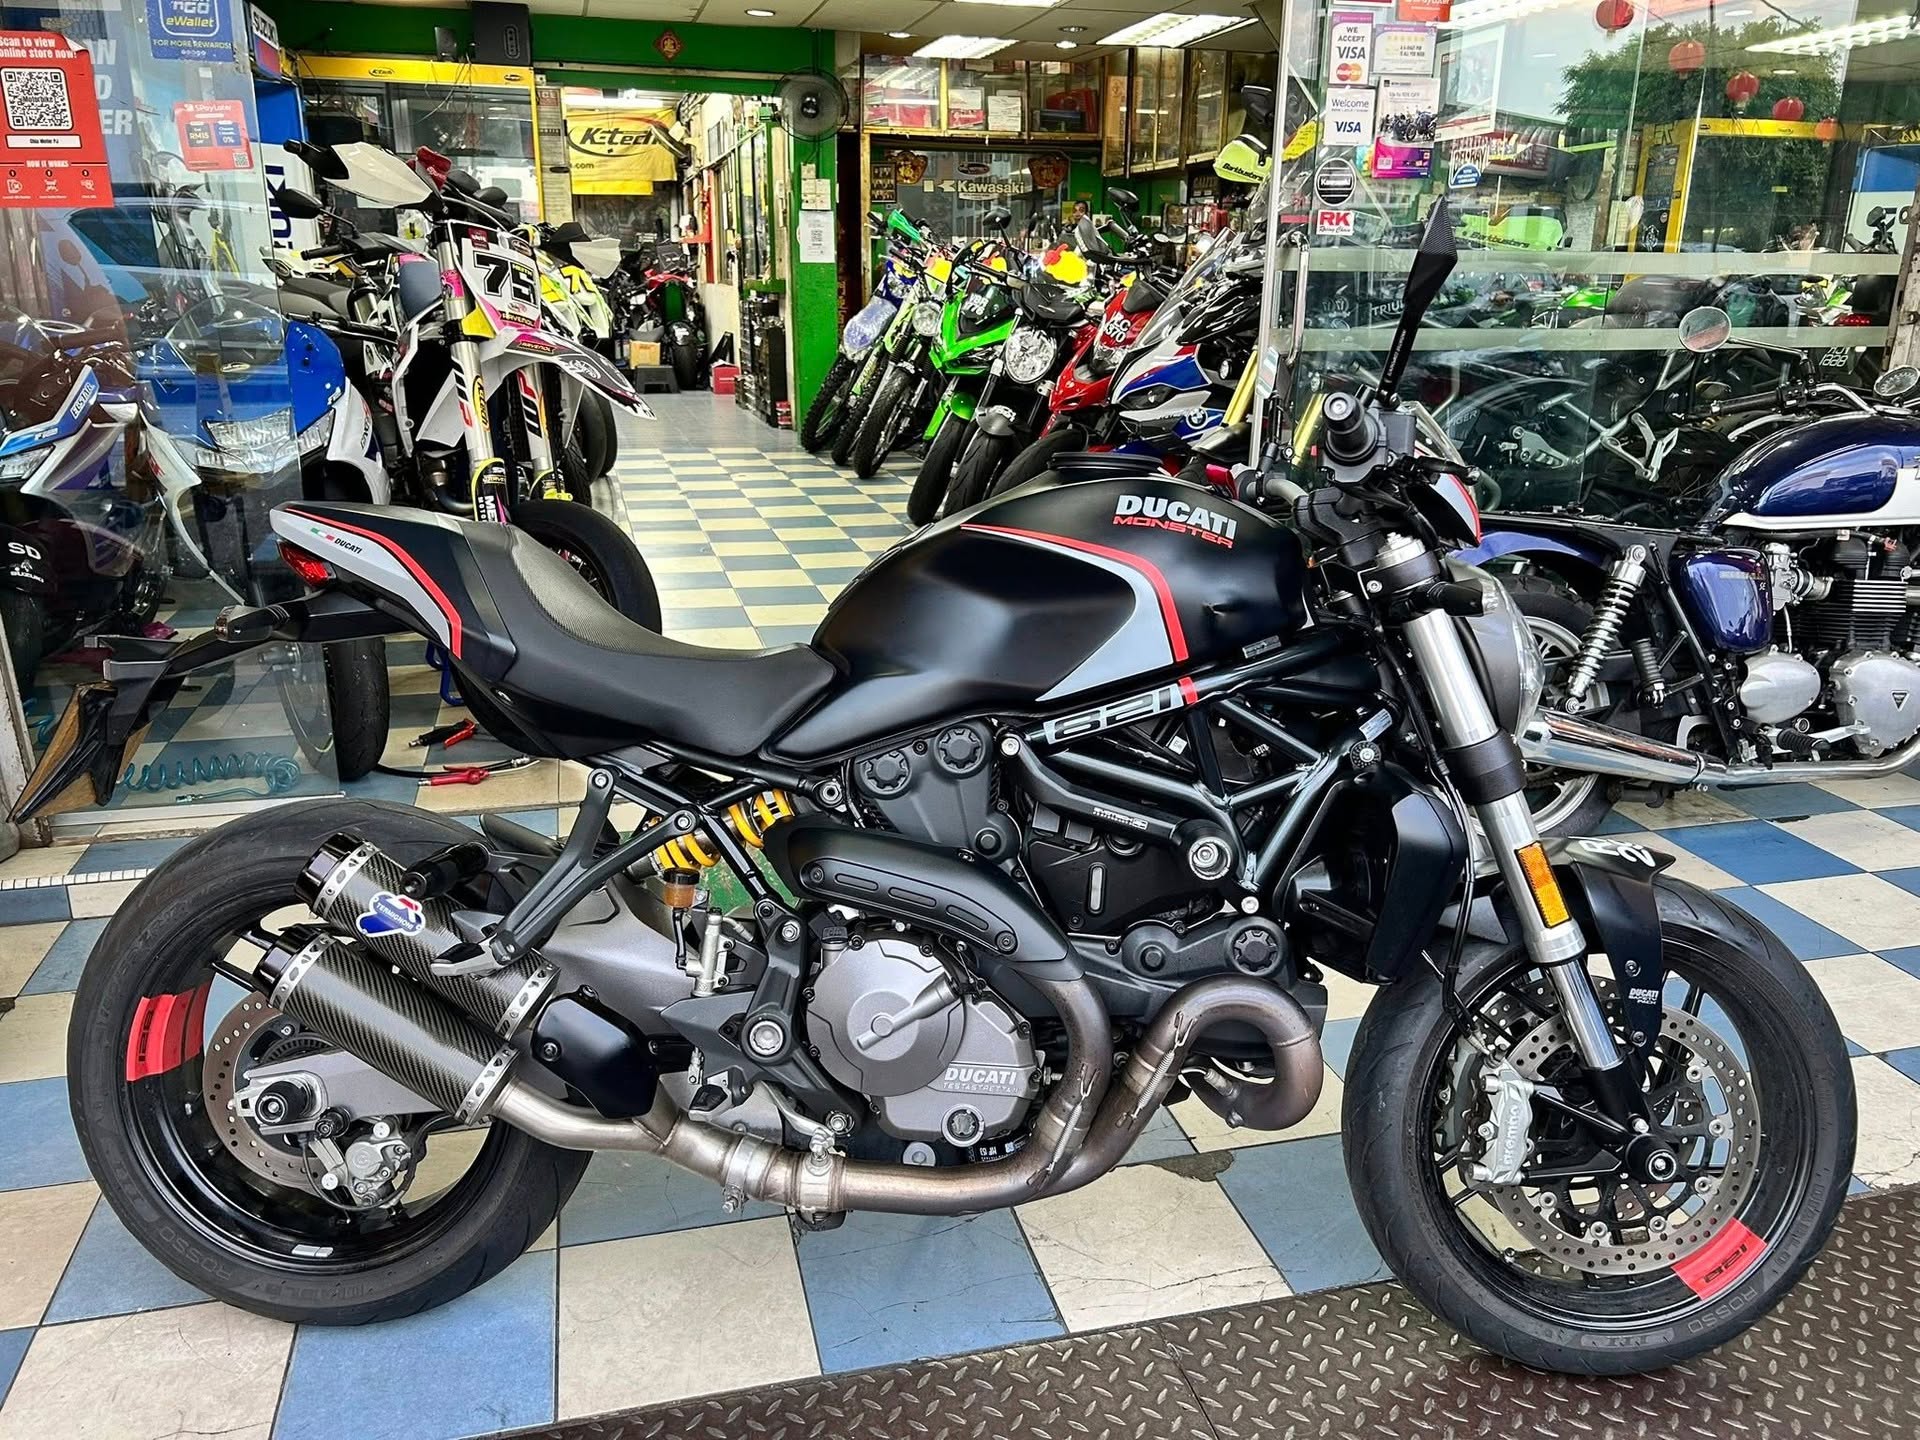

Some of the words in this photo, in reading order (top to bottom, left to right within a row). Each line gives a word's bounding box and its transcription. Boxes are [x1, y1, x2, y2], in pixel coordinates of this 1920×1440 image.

[166, 16, 214, 28] eWallet
[22, 37, 33, 47] to
[34, 36, 56, 47] view
[1338, 35, 1366, 43] ACCEPT
[0, 48, 27, 58] online
[29, 48, 53, 59] store
[1336, 46, 1366, 60] VISA
[1331, 99, 1370, 108] Welcome
[1335, 121, 1362, 133] VISA
[957, 180, 1025, 195] Kawasaki
[1319, 212, 1350, 226] RK
[473, 250, 539, 310] 75
[1115, 494, 1238, 541] DUCATI
[1112, 515, 1234, 549] MONSTER
[334, 537, 363, 554] DUCATI
[1054, 687, 1172, 741] 821
[376, 902, 414, 931] TERMIGNONI
[1629, 987, 1659, 998] DUCATI
[944, 1067, 1017, 1085] DUCATI
[1503, 1103, 1520, 1166] brembo
[159, 1226, 233, 1281] ROSSO
[1687, 1286, 1758, 1334] ROSSO
